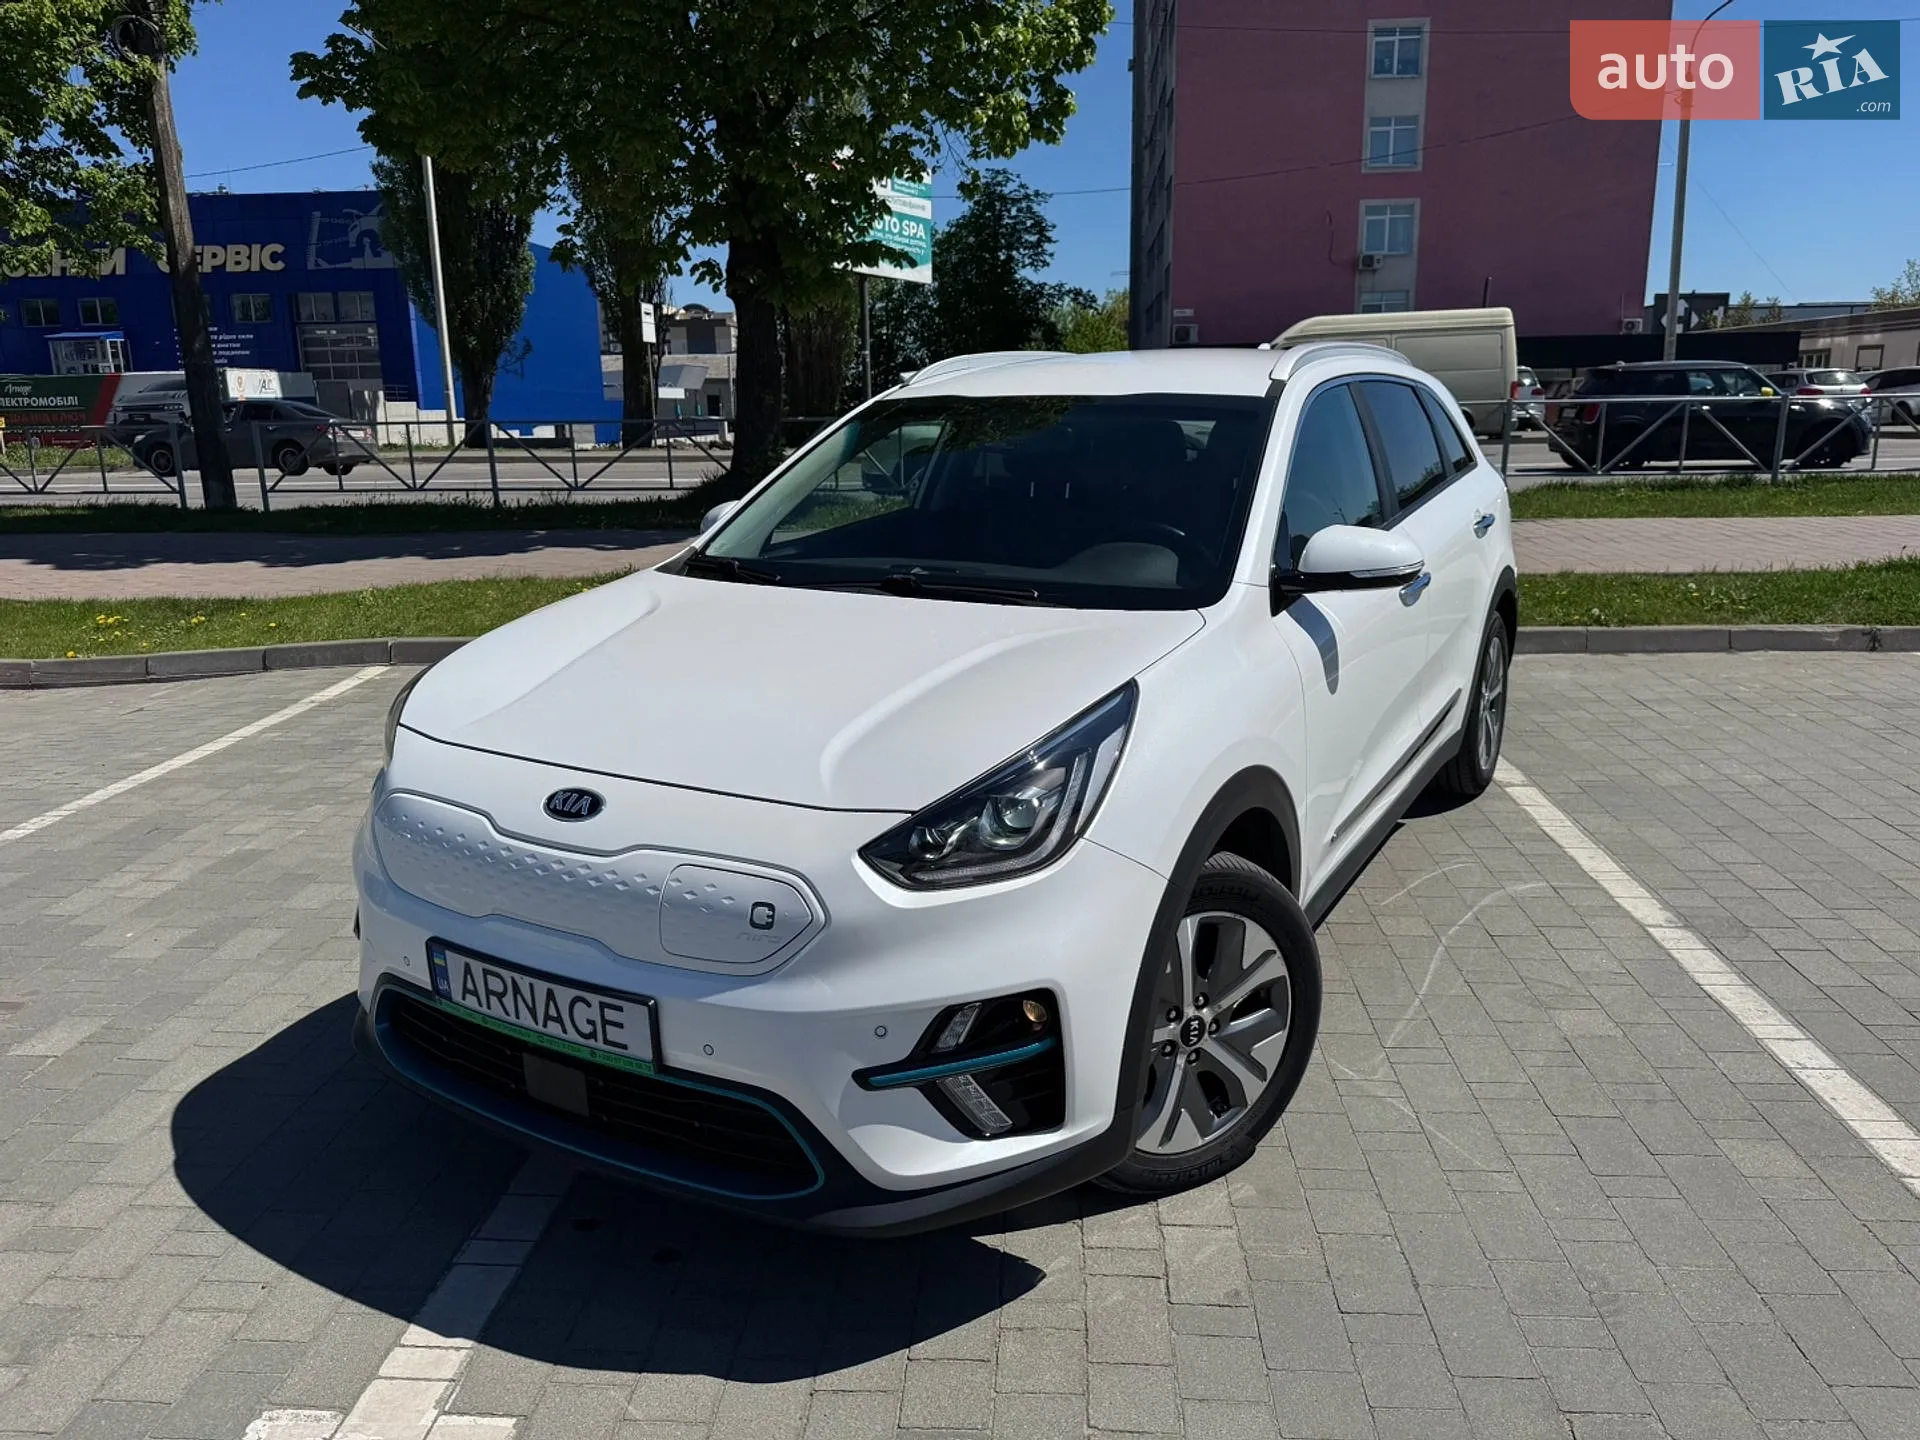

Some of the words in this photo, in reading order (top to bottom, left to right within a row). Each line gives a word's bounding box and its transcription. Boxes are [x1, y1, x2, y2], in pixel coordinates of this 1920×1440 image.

[901, 221, 926, 239] SPA
[549, 791, 592, 816] KIA
[461, 962, 628, 1050] ARNAGE
[1188, 1020, 1199, 1045] KIA
